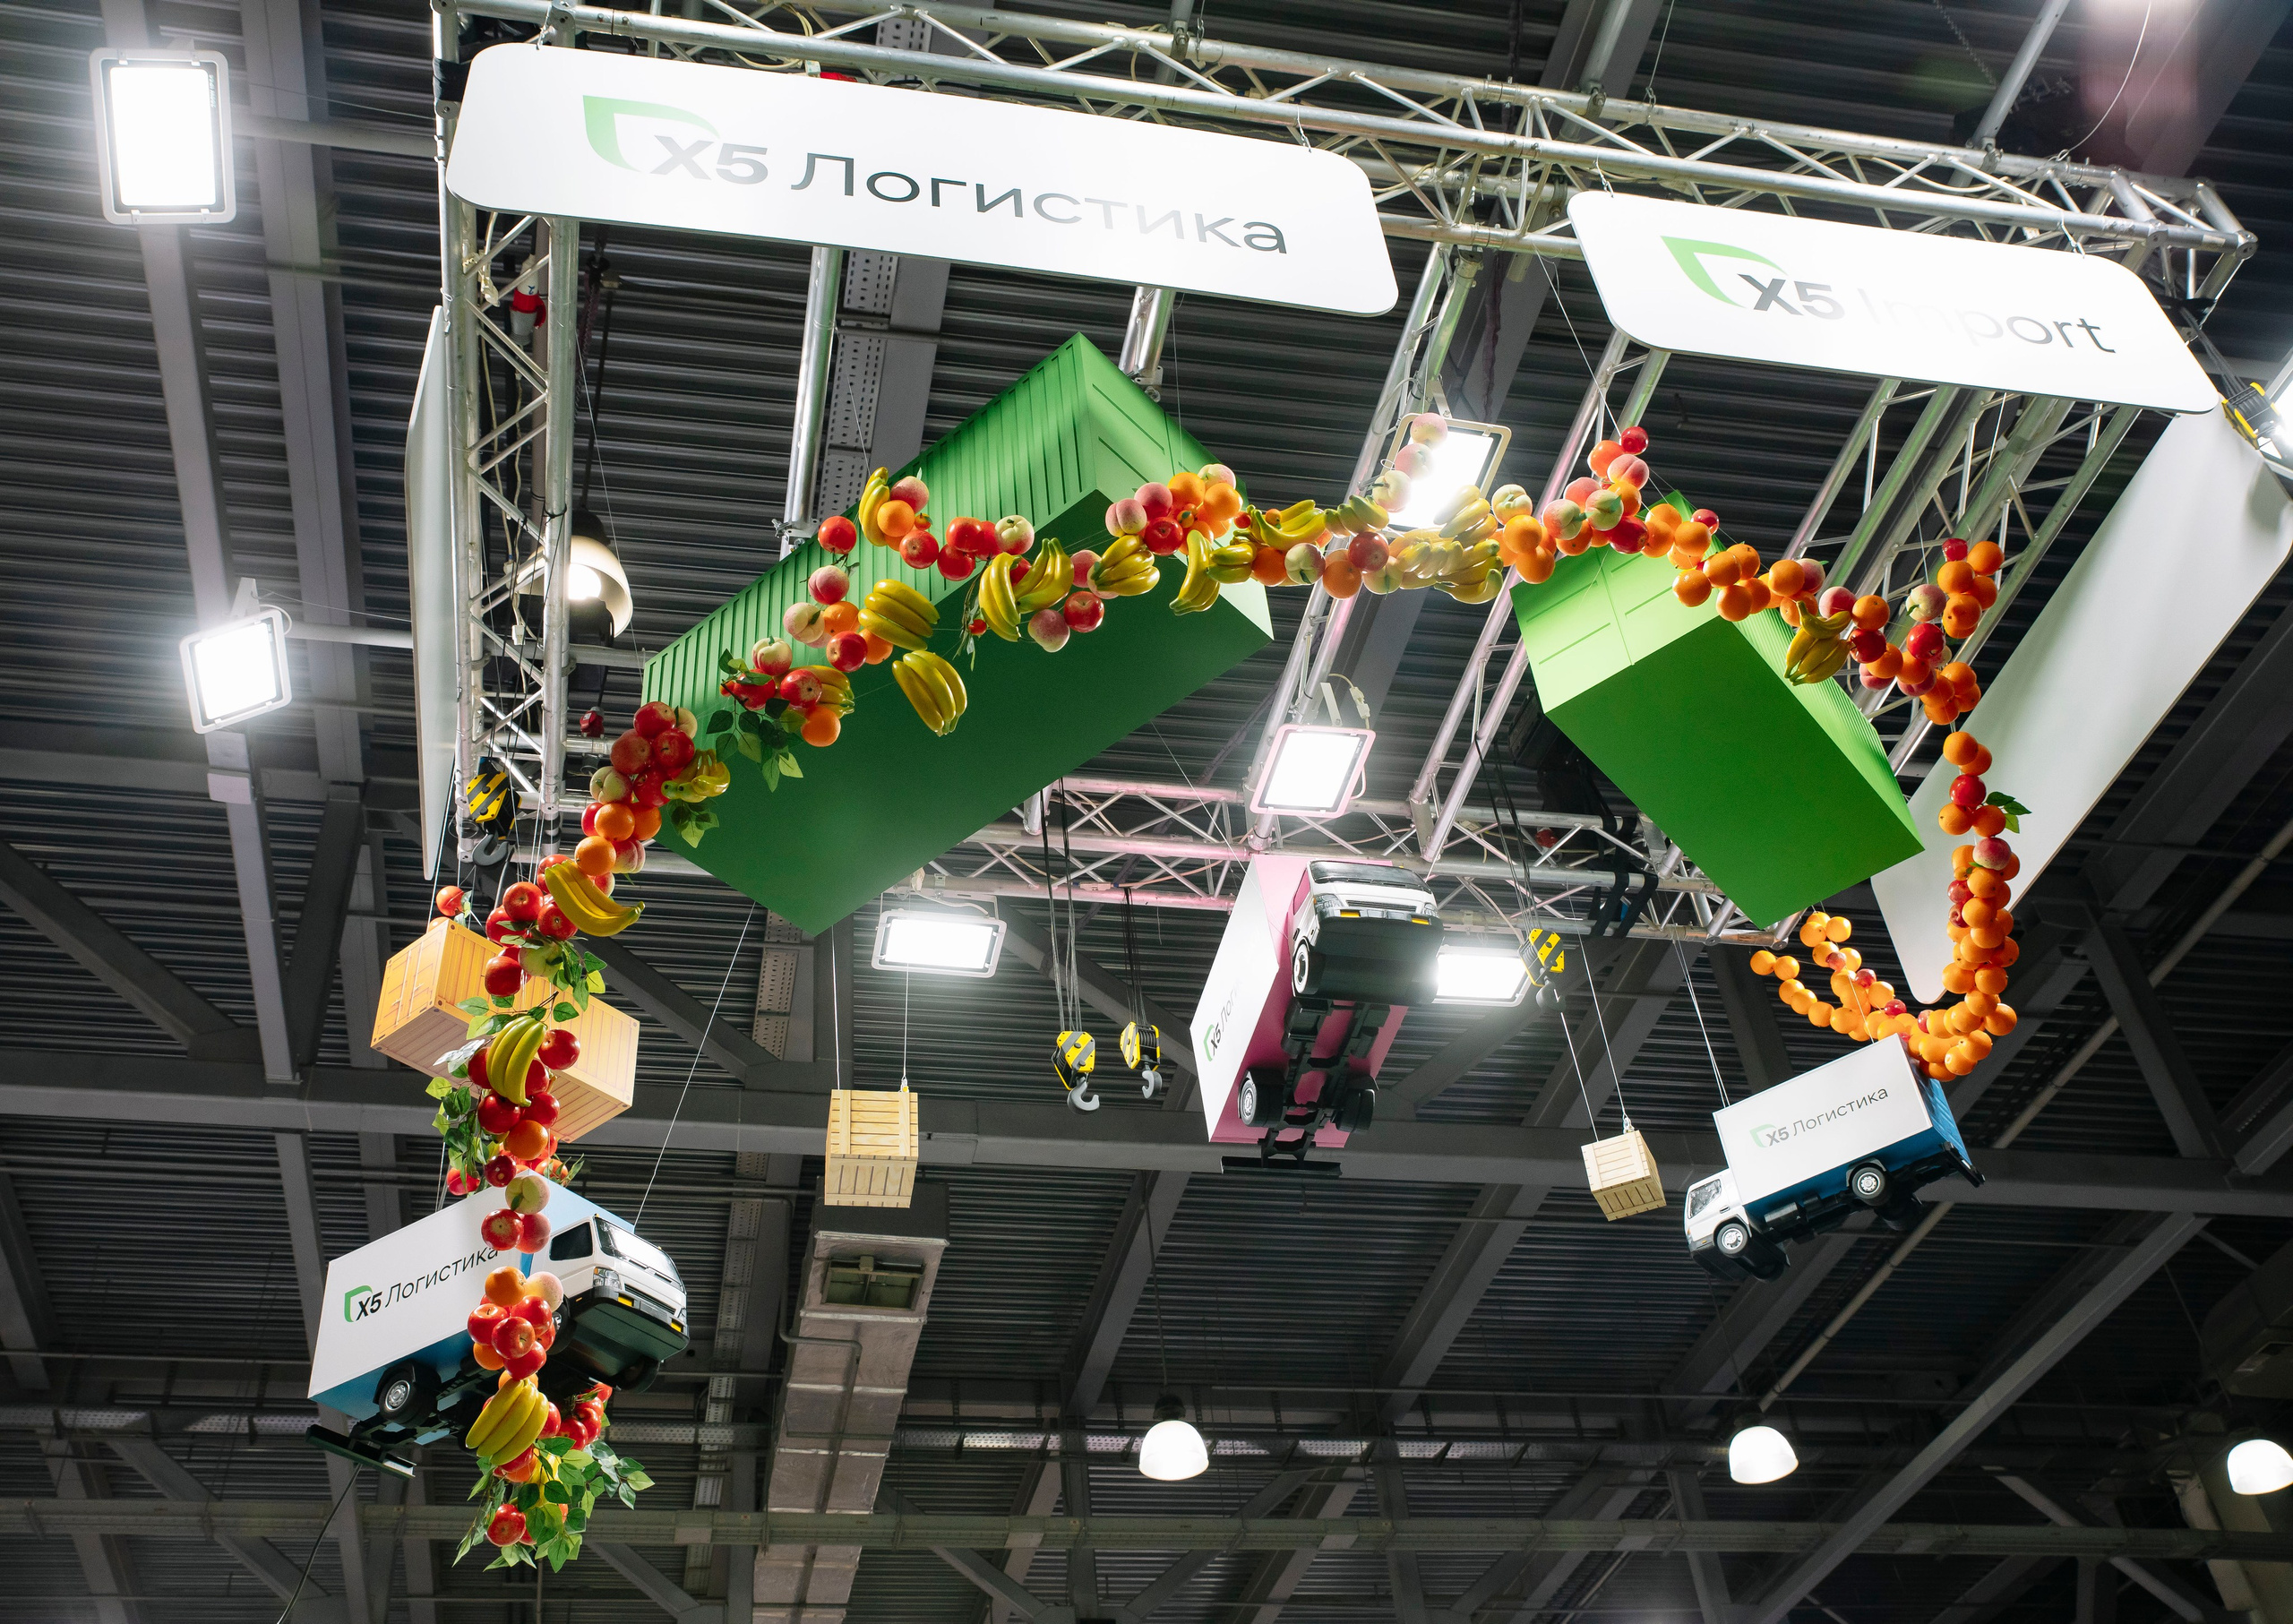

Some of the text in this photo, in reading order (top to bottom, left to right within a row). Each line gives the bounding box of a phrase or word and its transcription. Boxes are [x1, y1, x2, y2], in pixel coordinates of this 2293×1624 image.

[648, 133, 1290, 255] X5 Логистика
[1736, 272, 2117, 355] X5 Import
[1765, 1087, 1889, 1147] X5 Логистика
[355, 1246, 499, 1321] X5 Логистика
